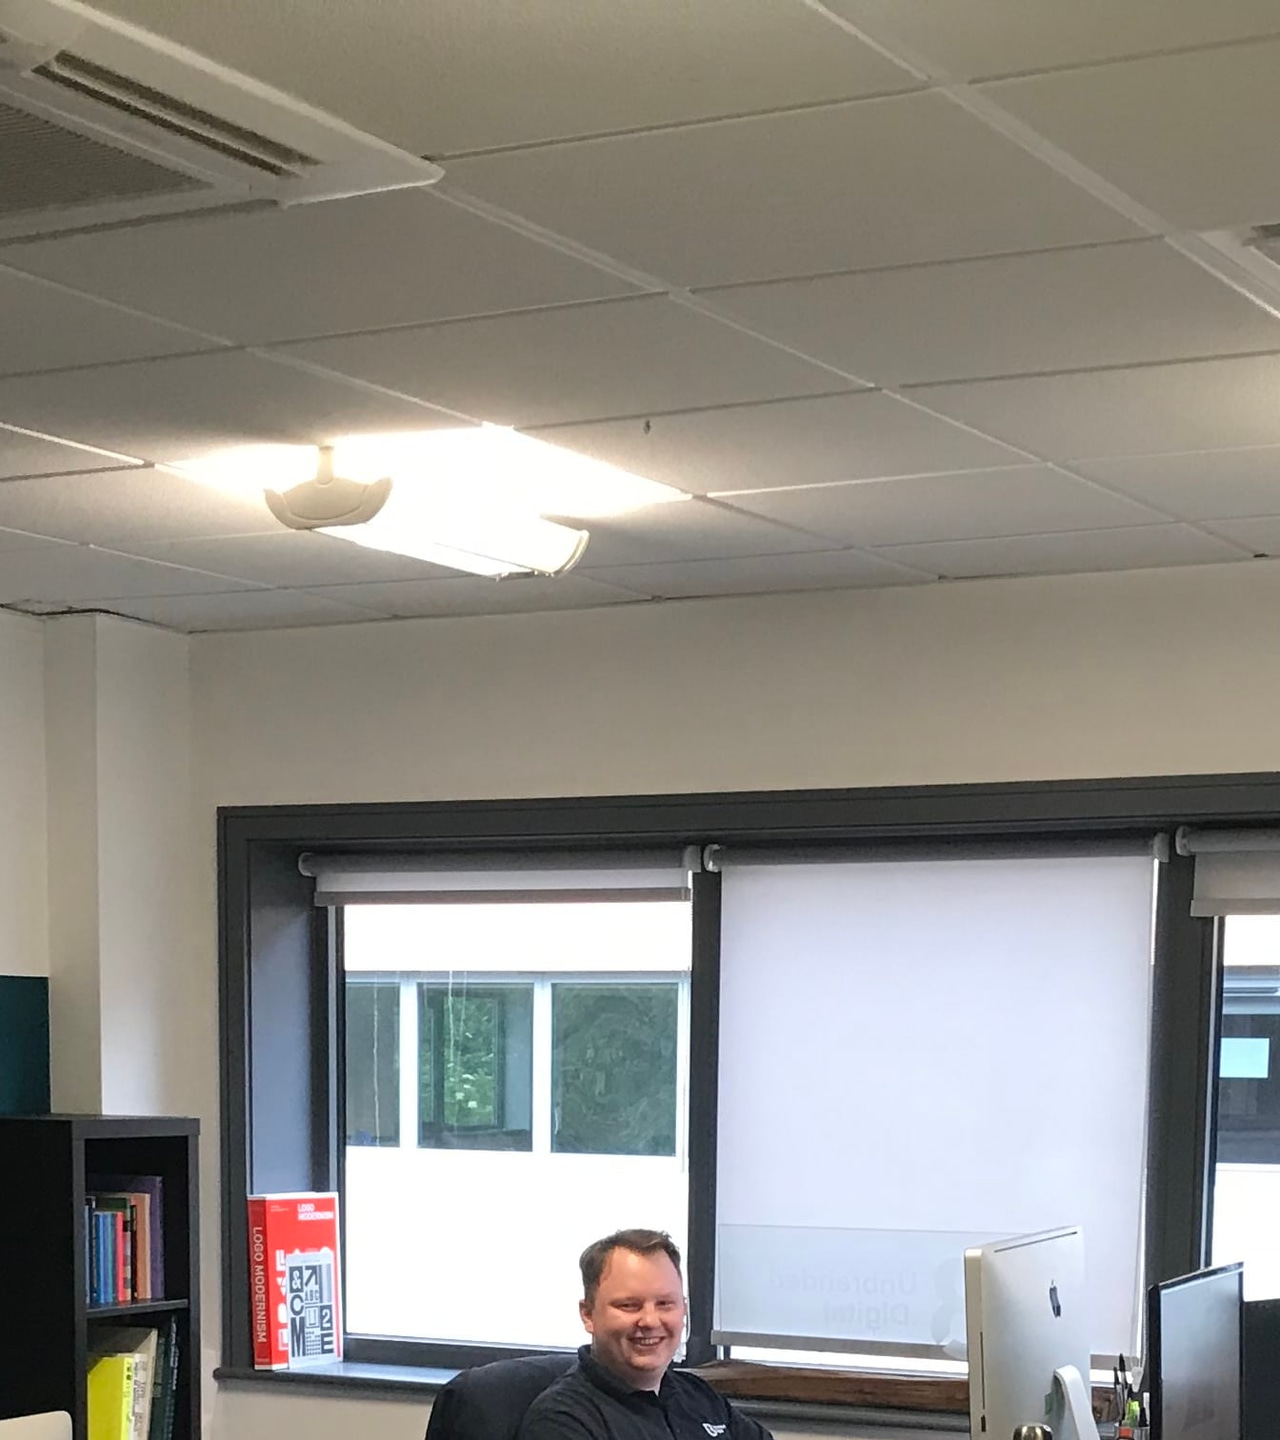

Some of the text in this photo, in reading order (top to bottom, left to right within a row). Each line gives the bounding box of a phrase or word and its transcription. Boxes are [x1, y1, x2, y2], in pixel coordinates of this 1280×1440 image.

[253, 1227, 267, 1342] LOGO MODERNISM
[290, 1294, 304, 1316] C
[322, 1308, 331, 1327] 2
[291, 1317, 306, 1357] M
[321, 1333, 334, 1354] E
